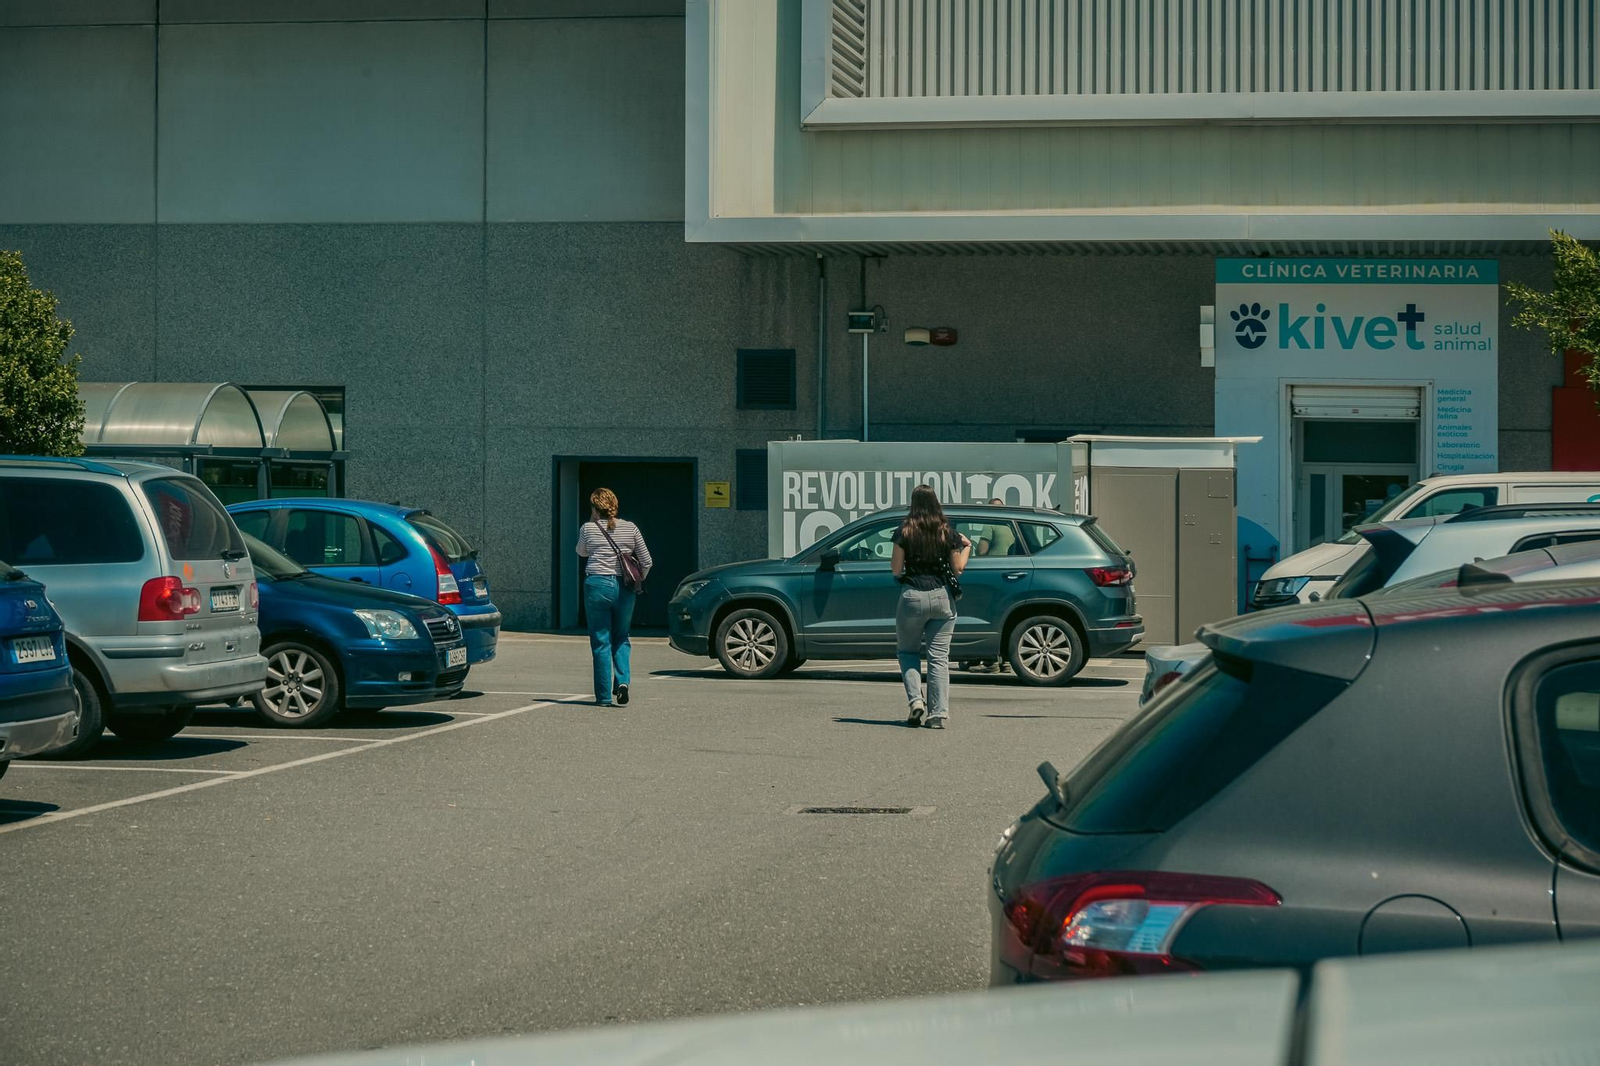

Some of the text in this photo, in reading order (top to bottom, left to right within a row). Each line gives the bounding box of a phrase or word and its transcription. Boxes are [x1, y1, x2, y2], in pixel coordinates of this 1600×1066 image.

[1242, 262, 1479, 278] CLÍNICA VETERINARIA
[1278, 303, 1425, 350] kivet
[1433, 321, 1481, 335] salud
[1433, 337, 1491, 350] animal
[1437, 452, 1495, 460] Hospitalización
[16, 640, 38, 659] 2597
